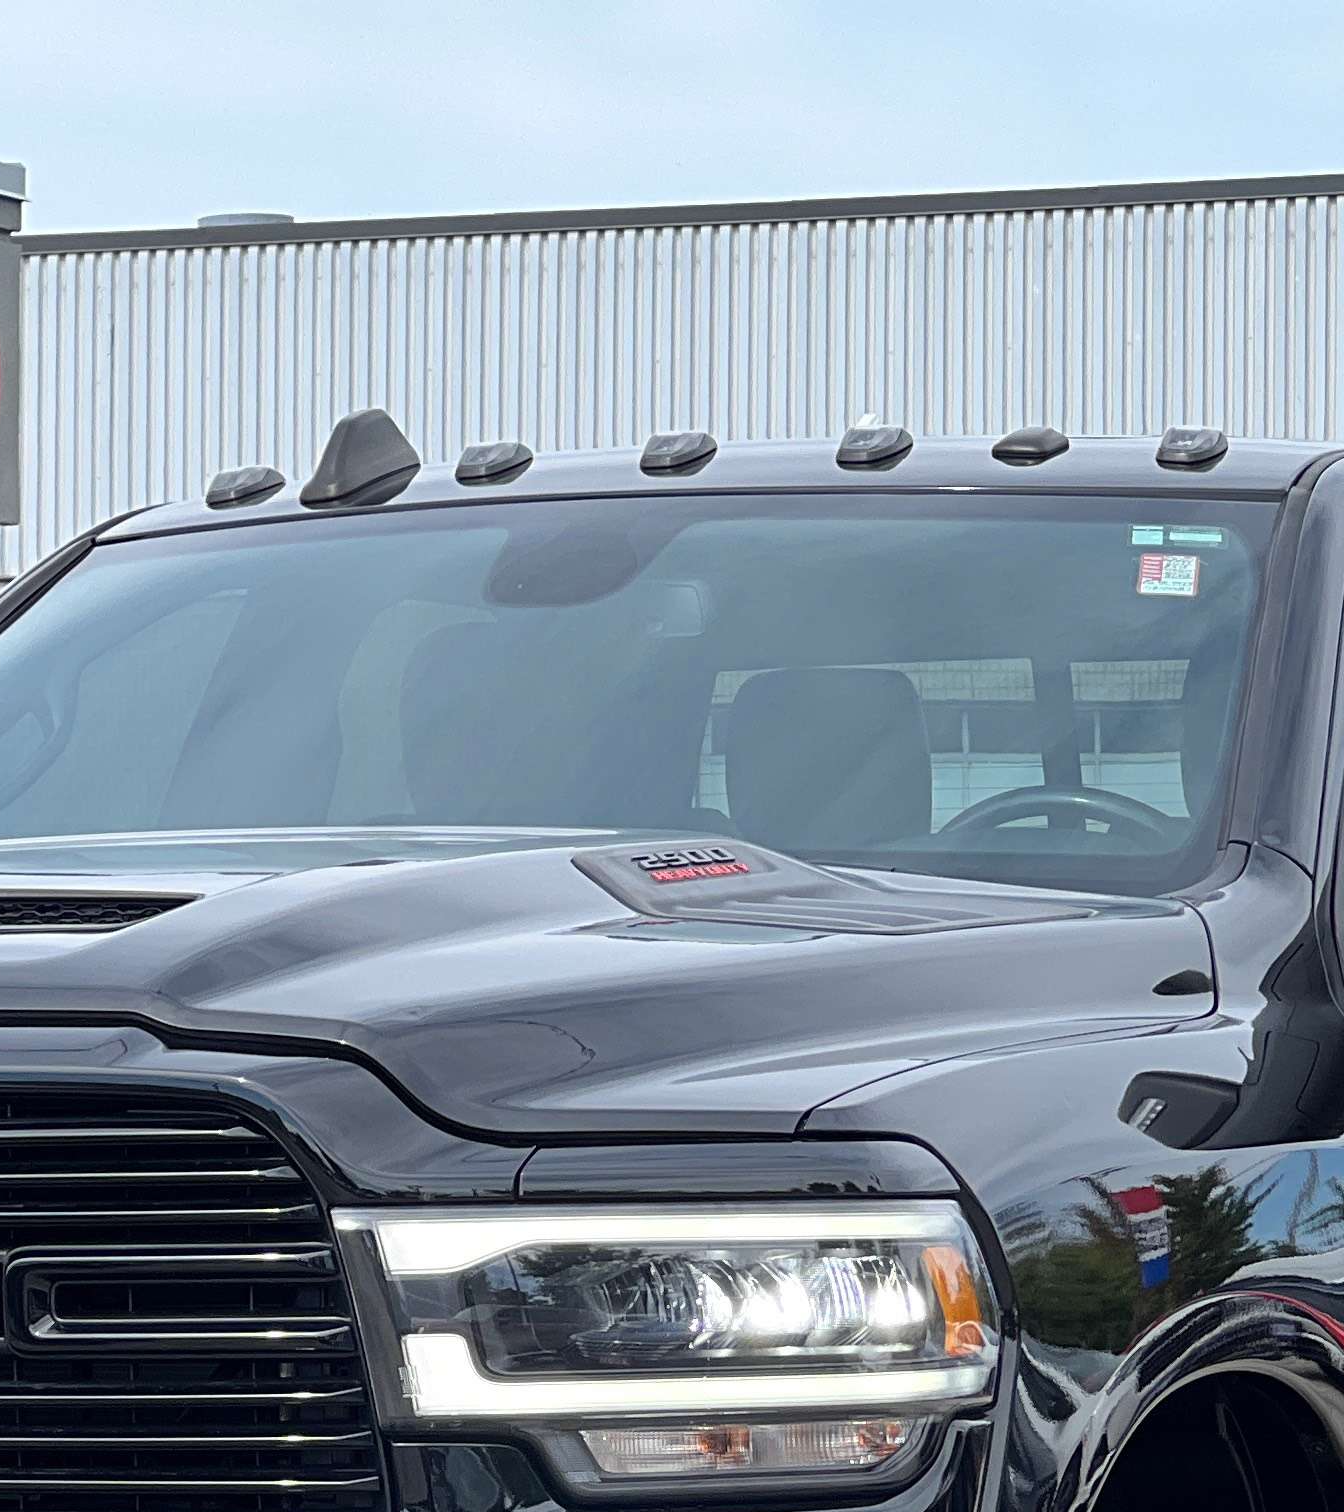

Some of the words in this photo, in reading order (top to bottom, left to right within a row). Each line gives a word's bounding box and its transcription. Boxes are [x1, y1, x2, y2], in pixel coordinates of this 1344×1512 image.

[631, 847, 736, 870] 2500
[650, 867, 706, 881] HEAVY
[704, 863, 750, 876] DUTY
